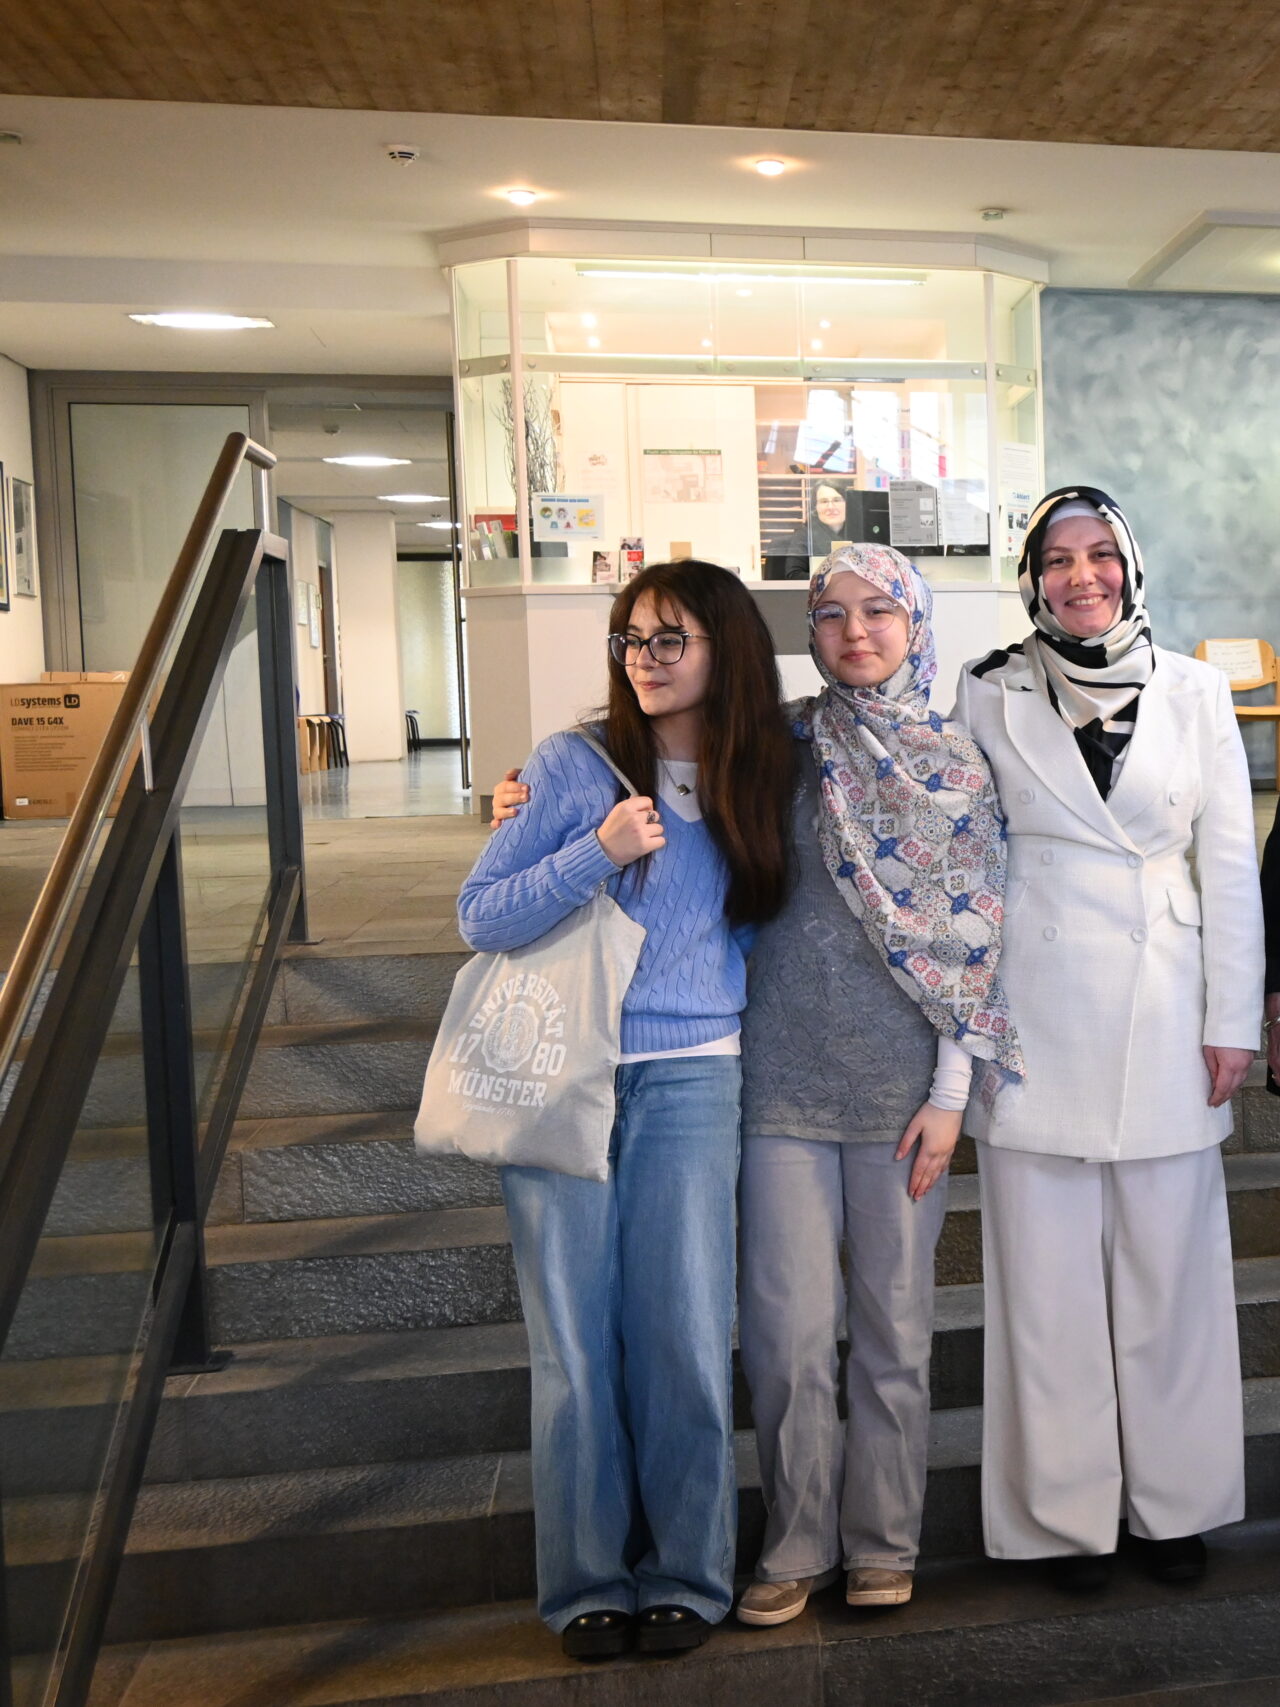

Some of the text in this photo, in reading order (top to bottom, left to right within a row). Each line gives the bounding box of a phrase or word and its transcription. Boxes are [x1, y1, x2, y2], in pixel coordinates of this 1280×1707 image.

[11, 717, 64, 726] DAVE 15 G4X
[469, 974, 566, 1038] UNIVERSITÄT
[450, 1032, 482, 1064] 17
[531, 1042, 567, 1076] 80
[447, 1068, 547, 1109] MÜNSTER
